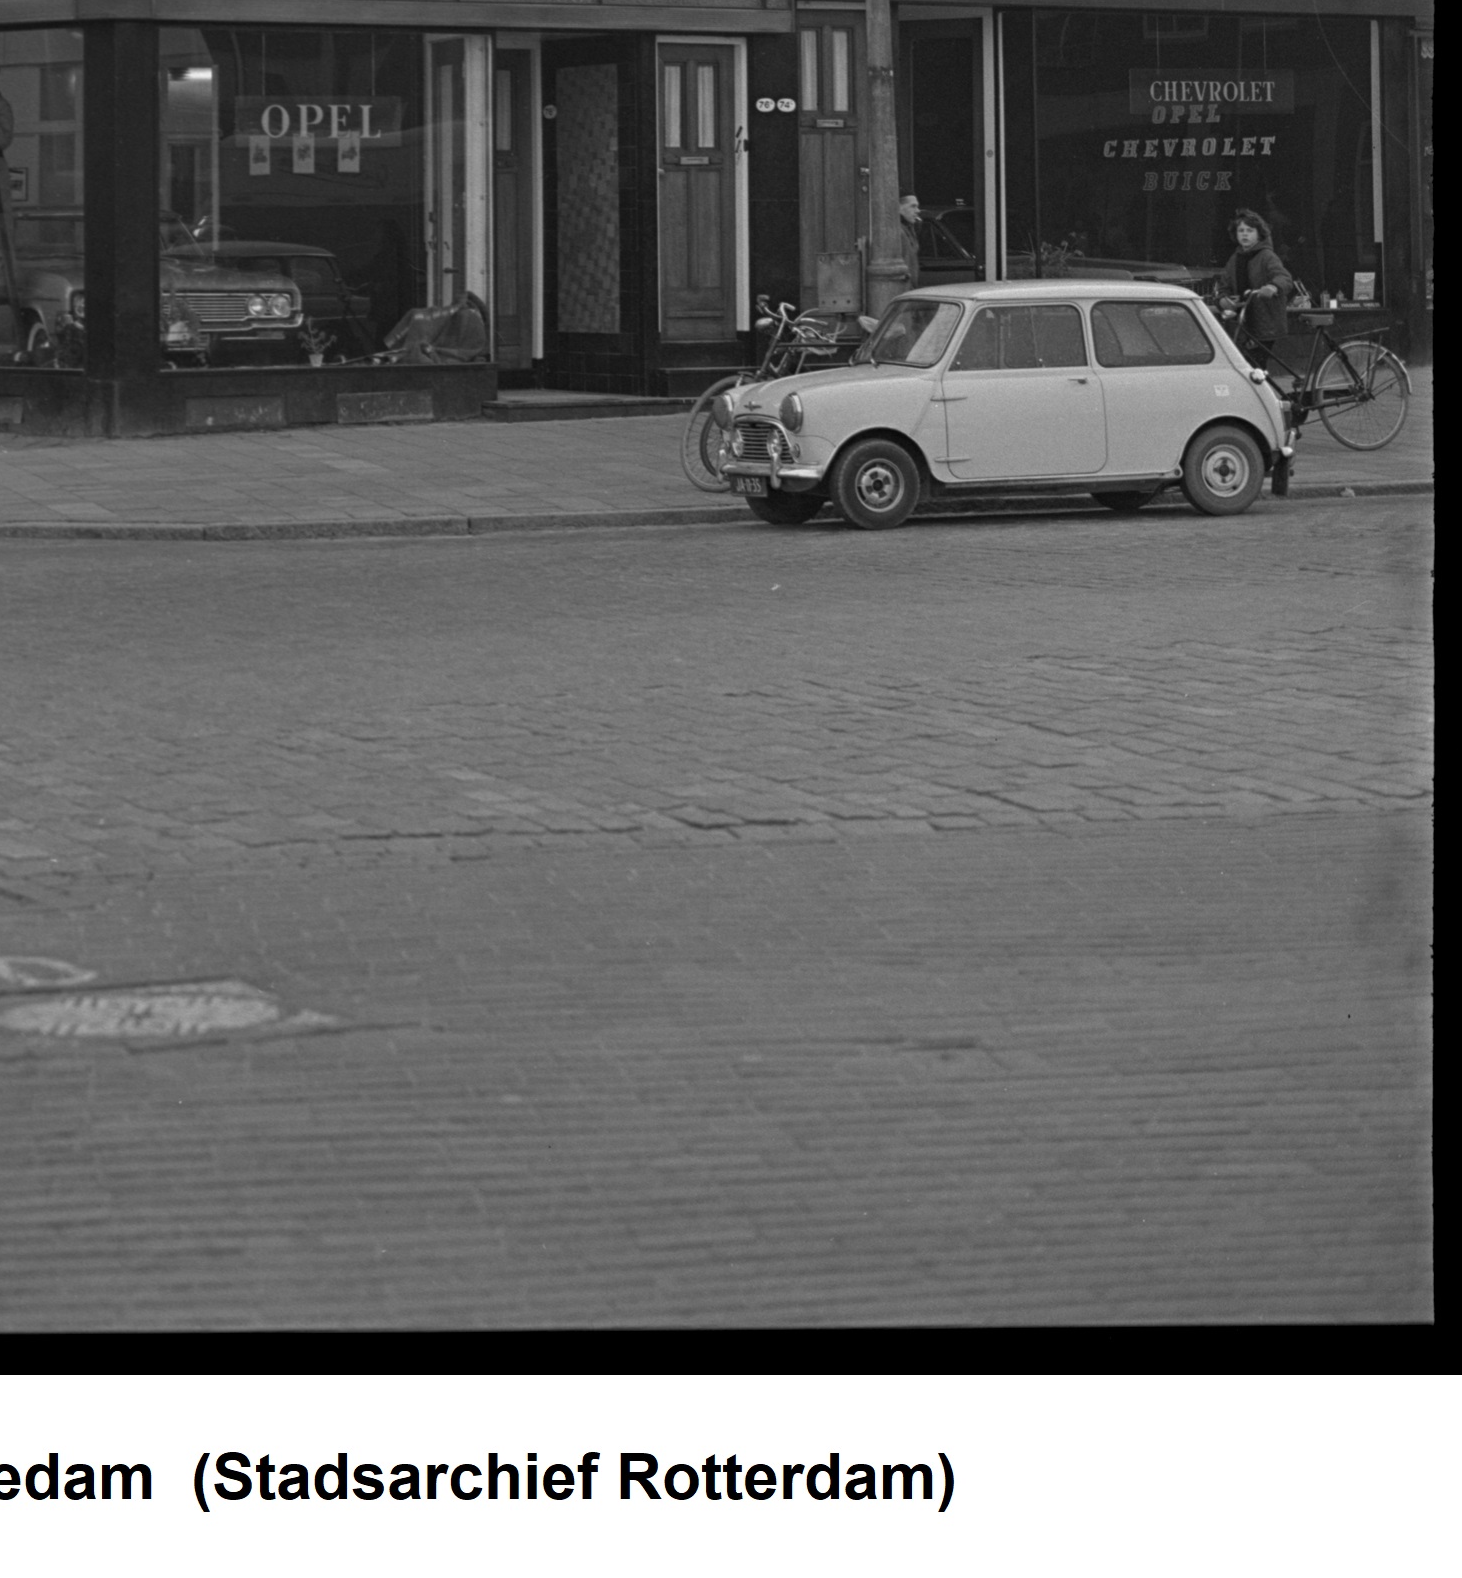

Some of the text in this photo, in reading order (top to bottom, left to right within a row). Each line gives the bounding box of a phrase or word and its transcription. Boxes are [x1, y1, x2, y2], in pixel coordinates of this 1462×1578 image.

[1149, 80, 1276, 103] CHEVROLET
[261, 103, 382, 139] OPEL
[1152, 103, 1222, 124] OPEL
[1103, 135, 1276, 158] CHEVROLET
[1143, 171, 1233, 191] BUICK
